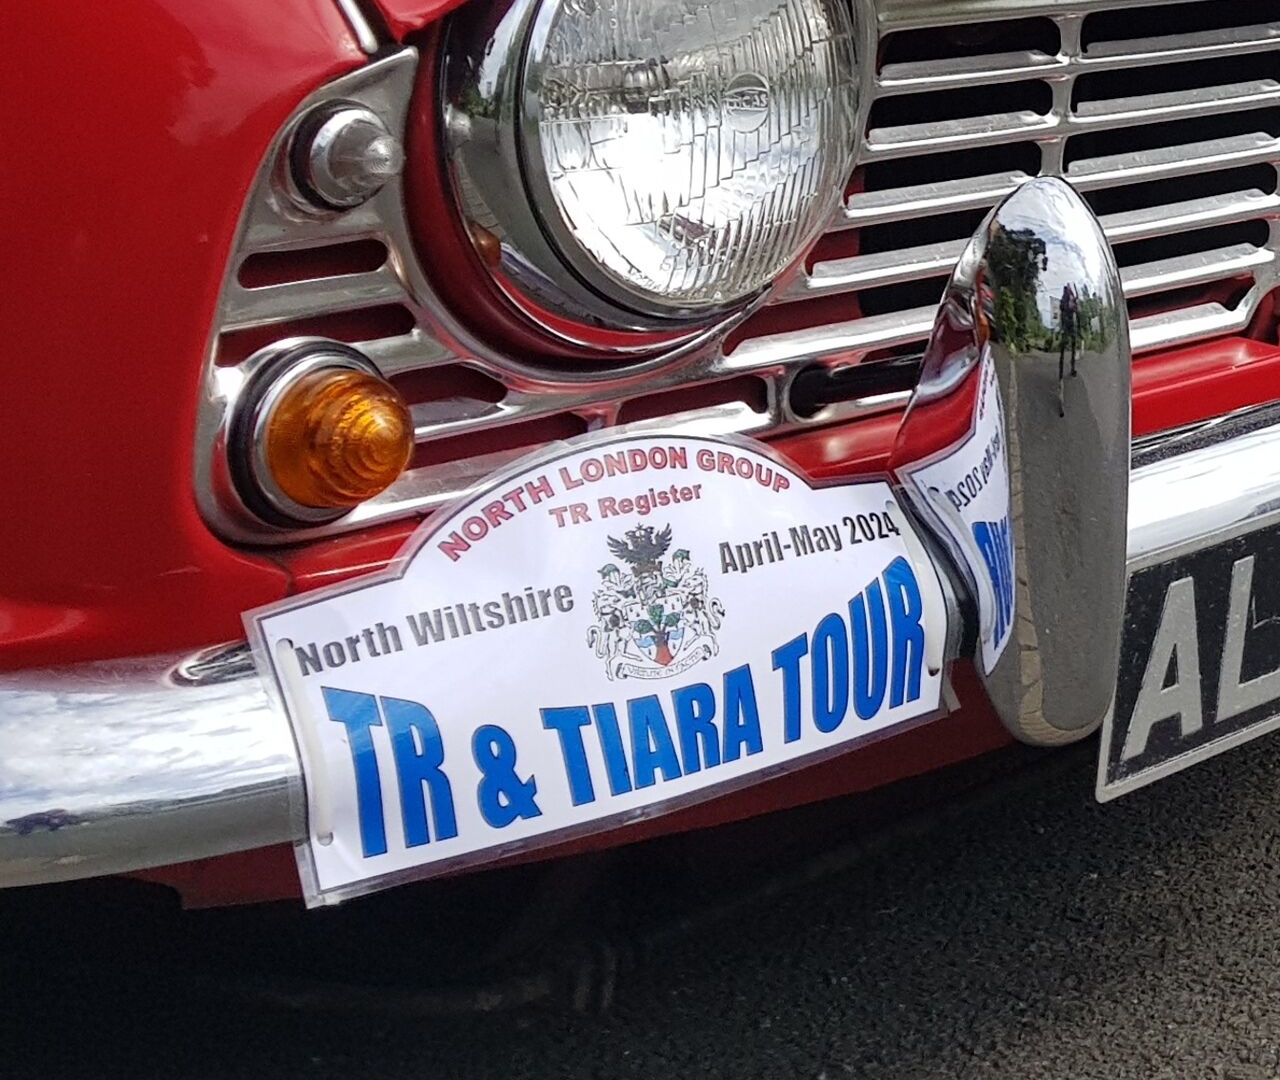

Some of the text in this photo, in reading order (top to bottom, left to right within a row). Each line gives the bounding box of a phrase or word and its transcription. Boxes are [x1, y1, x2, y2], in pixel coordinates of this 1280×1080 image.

[437, 446, 790, 562] NORTH LONDON GROUP
[549, 484, 702, 528] TR Register
[718, 512, 901, 574] April-May 2024
[295, 584, 574, 676] North Wiltshire
[320, 686, 458, 858] TR
[471, 724, 542, 828] &
[539, 664, 763, 807] TIARA
[772, 554, 925, 744] TOUR
